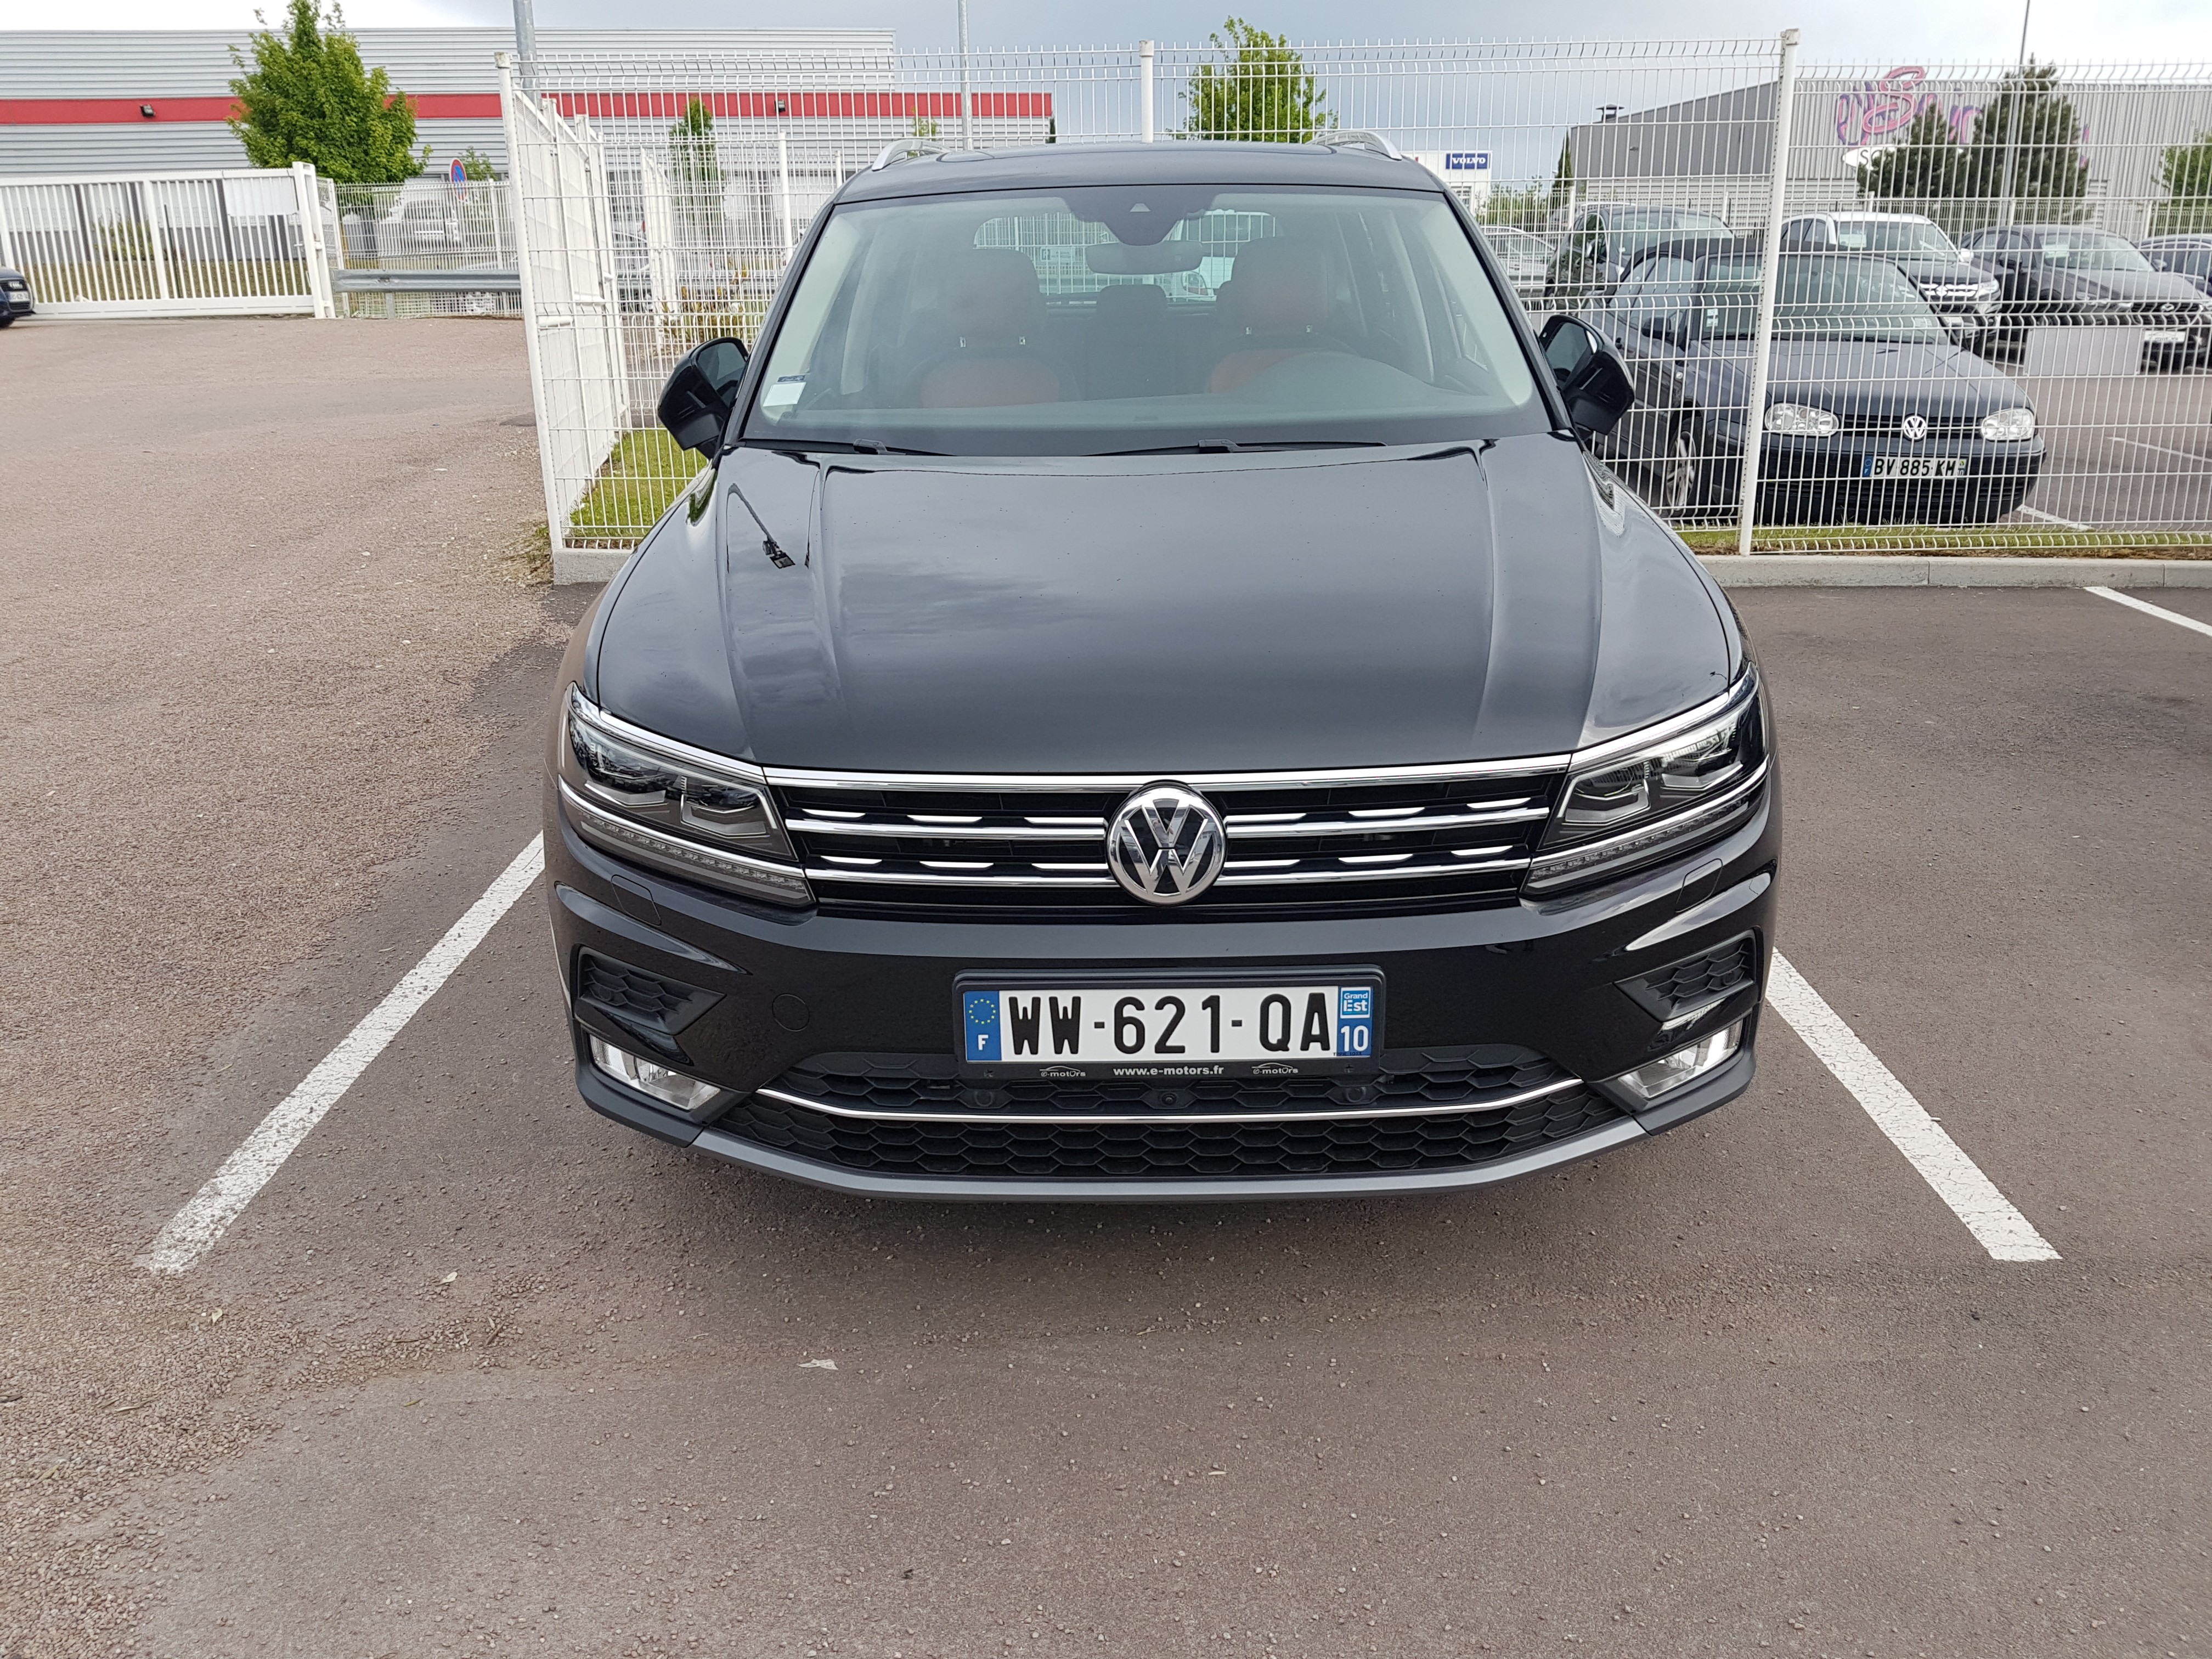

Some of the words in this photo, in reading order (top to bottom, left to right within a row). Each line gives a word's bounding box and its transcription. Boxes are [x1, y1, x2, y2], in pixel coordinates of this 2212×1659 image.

[1343, 1000, 1368, 1012] Est
[978, 1034, 989, 1051] F
[1008, 992, 1330, 1055] WW-621-QA
[1341, 1025, 1369, 1052] 10
[1113, 1065, 1224, 1076] www.e-motors.fr
